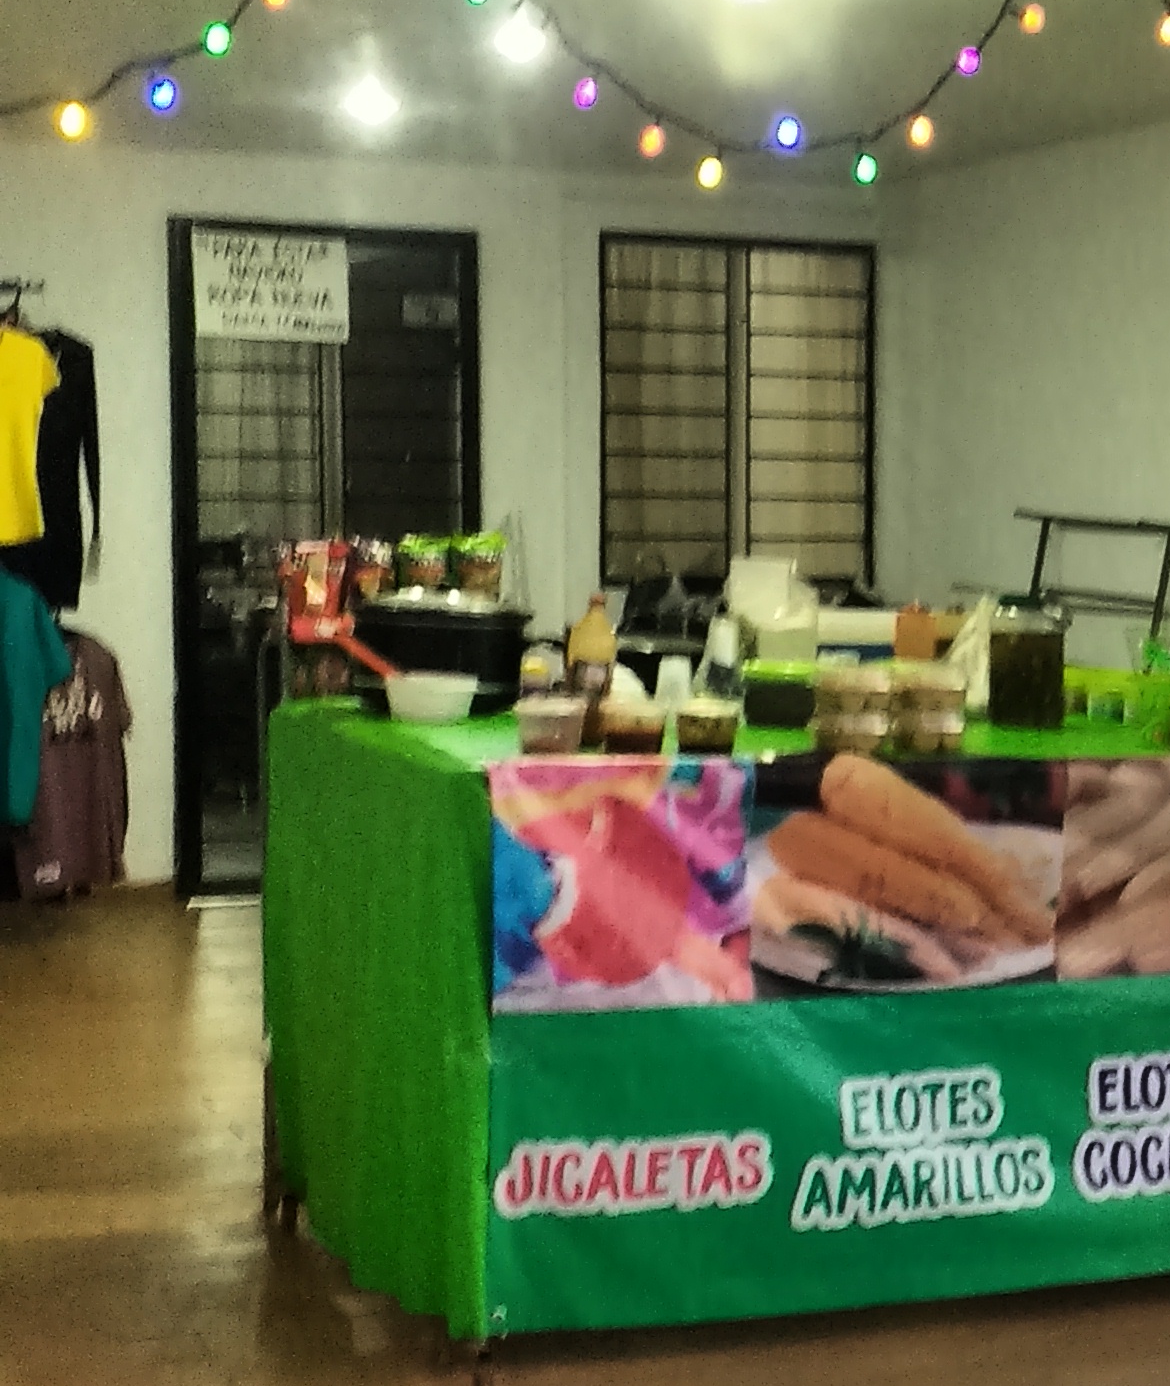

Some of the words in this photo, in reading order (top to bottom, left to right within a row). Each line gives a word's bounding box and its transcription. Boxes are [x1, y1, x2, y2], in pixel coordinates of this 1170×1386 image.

[850, 1077, 995, 1140] ELOTES
[506, 1142, 762, 1207] JICALETAS
[803, 1146, 1047, 1222] AMARILLOS
